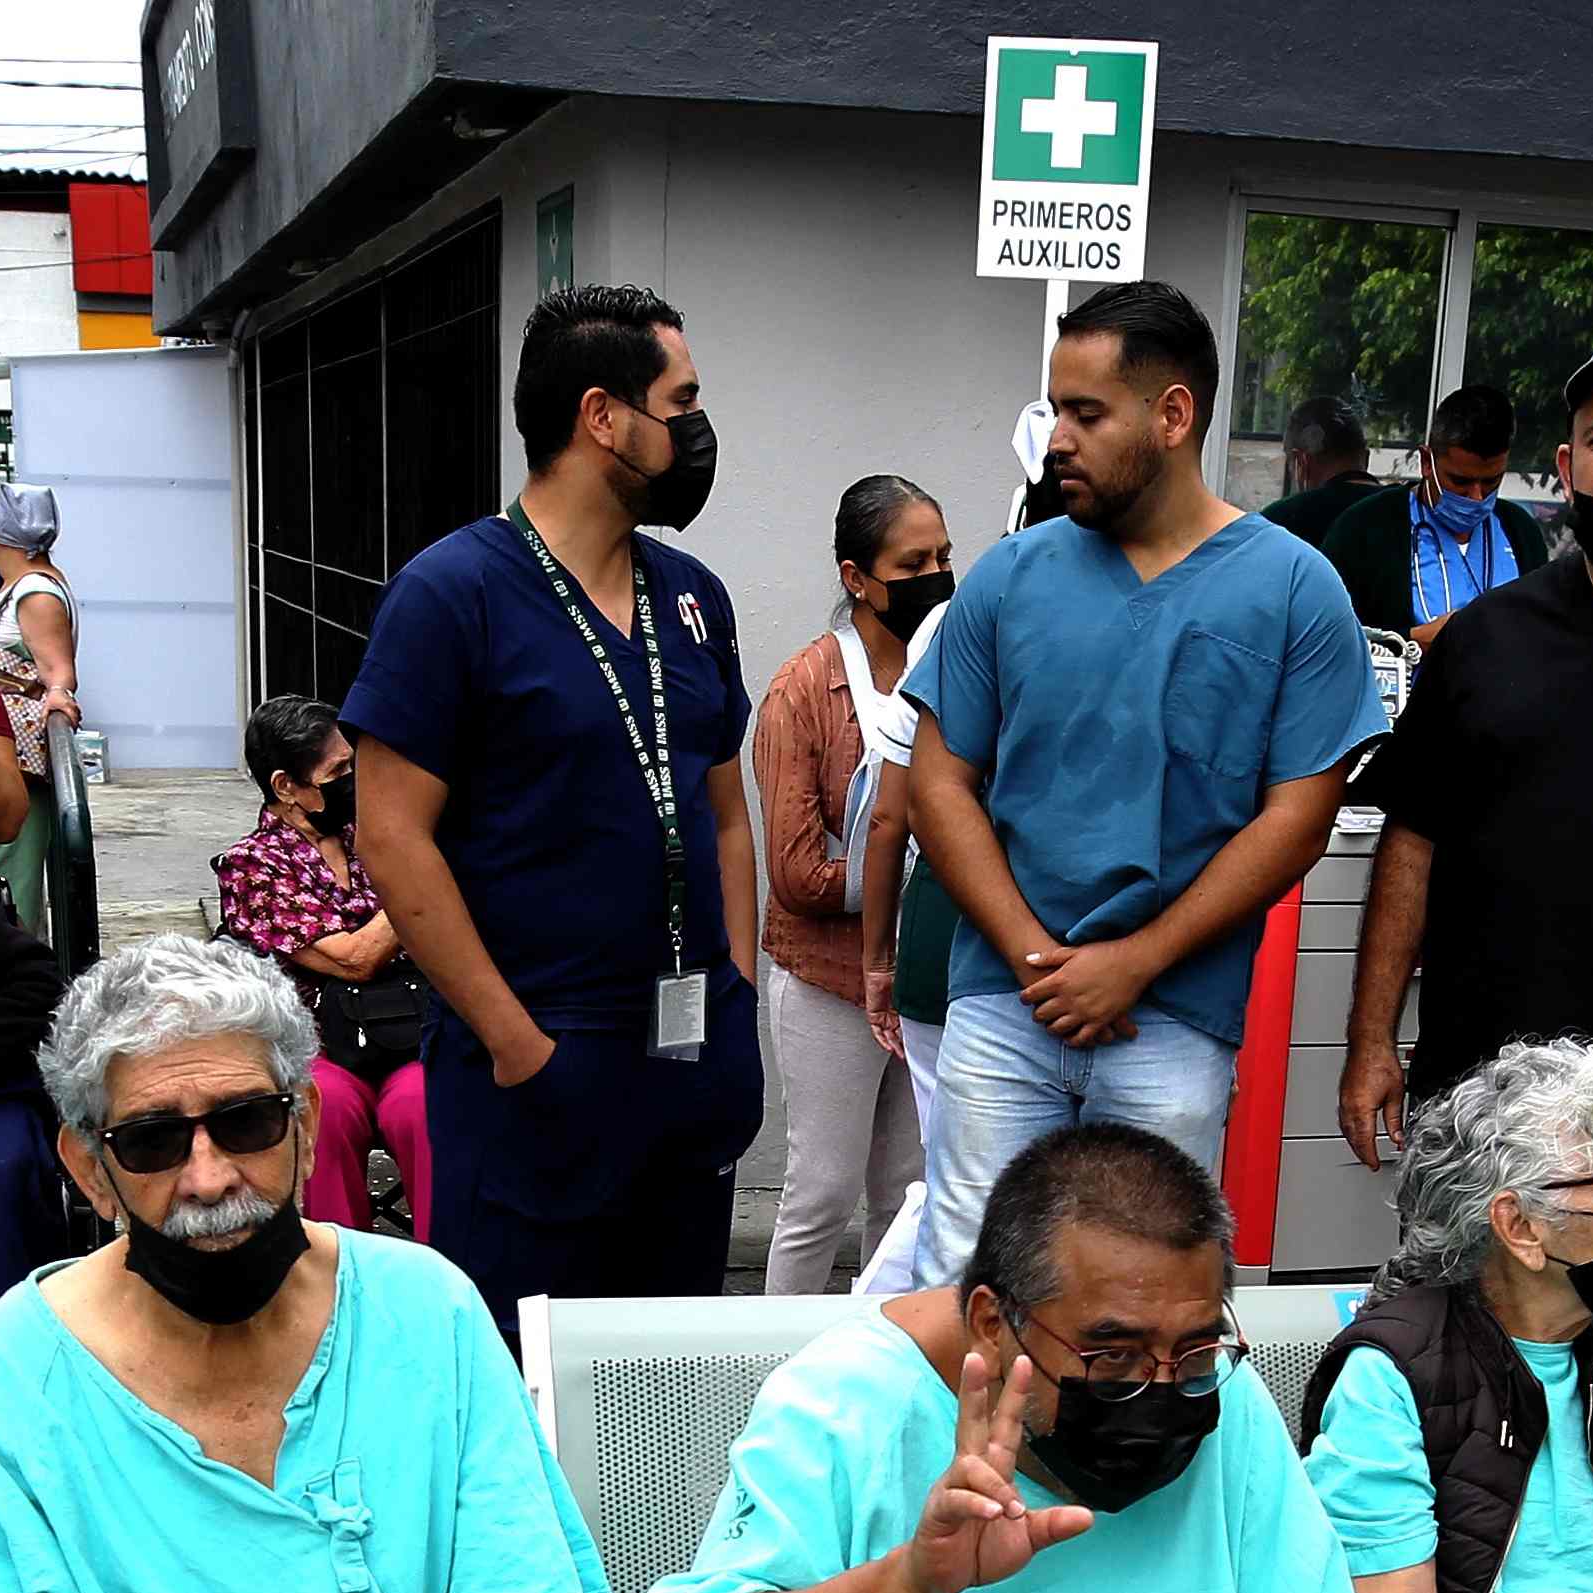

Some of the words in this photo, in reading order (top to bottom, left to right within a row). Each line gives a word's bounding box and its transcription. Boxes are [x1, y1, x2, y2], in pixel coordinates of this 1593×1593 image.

[993, 199, 1132, 231] PRIMEROS
[997, 238, 1121, 270] AUXILIOS
[524, 530, 556, 574] IMSS
[568, 605, 596, 642] IMSS
[637, 594, 655, 634] IMSS
[600, 662, 623, 695] IMSS
[649, 657, 664, 690] IMSS
[625, 715, 644, 749] IMSS
[655, 712, 667, 745] IMSS
[645, 768, 661, 802] IMSS
[659, 766, 674, 798] IMSS
